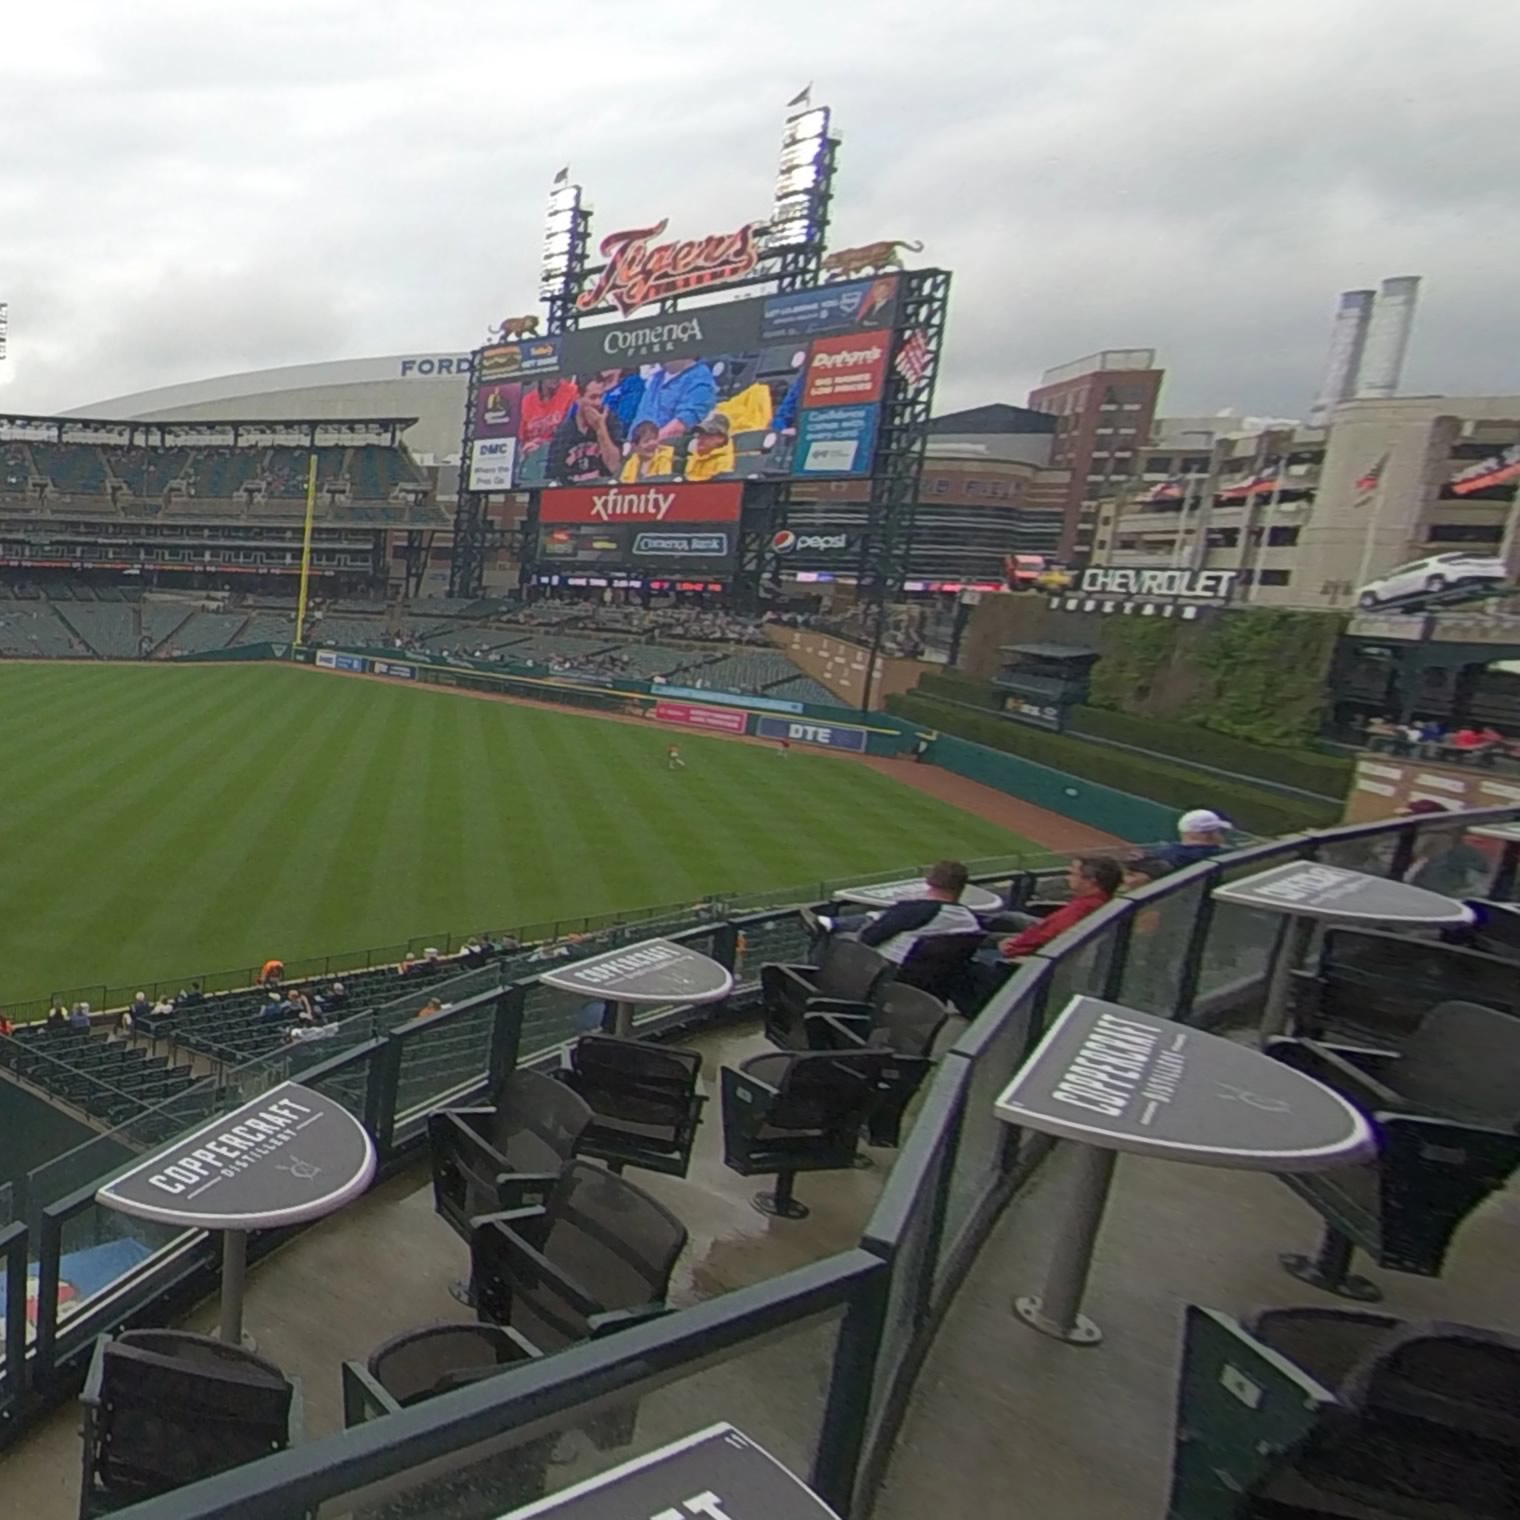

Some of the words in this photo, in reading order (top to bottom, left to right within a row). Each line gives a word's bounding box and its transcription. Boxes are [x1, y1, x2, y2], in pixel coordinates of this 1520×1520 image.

[576, 217, 757, 319] Tigers
[401, 358, 472, 377] FORD
[591, 488, 676, 521] xfinity
[796, 533, 847, 550] pepsi
[1081, 568, 1238, 597] CHEVROLET
[788, 723, 832, 744] DTE
[1052, 1013, 1162, 1116] COPPERCRAFT
[148, 1098, 312, 1195] COPPERCRAFT
[221, 1128, 298, 1178] DISTILLERY
